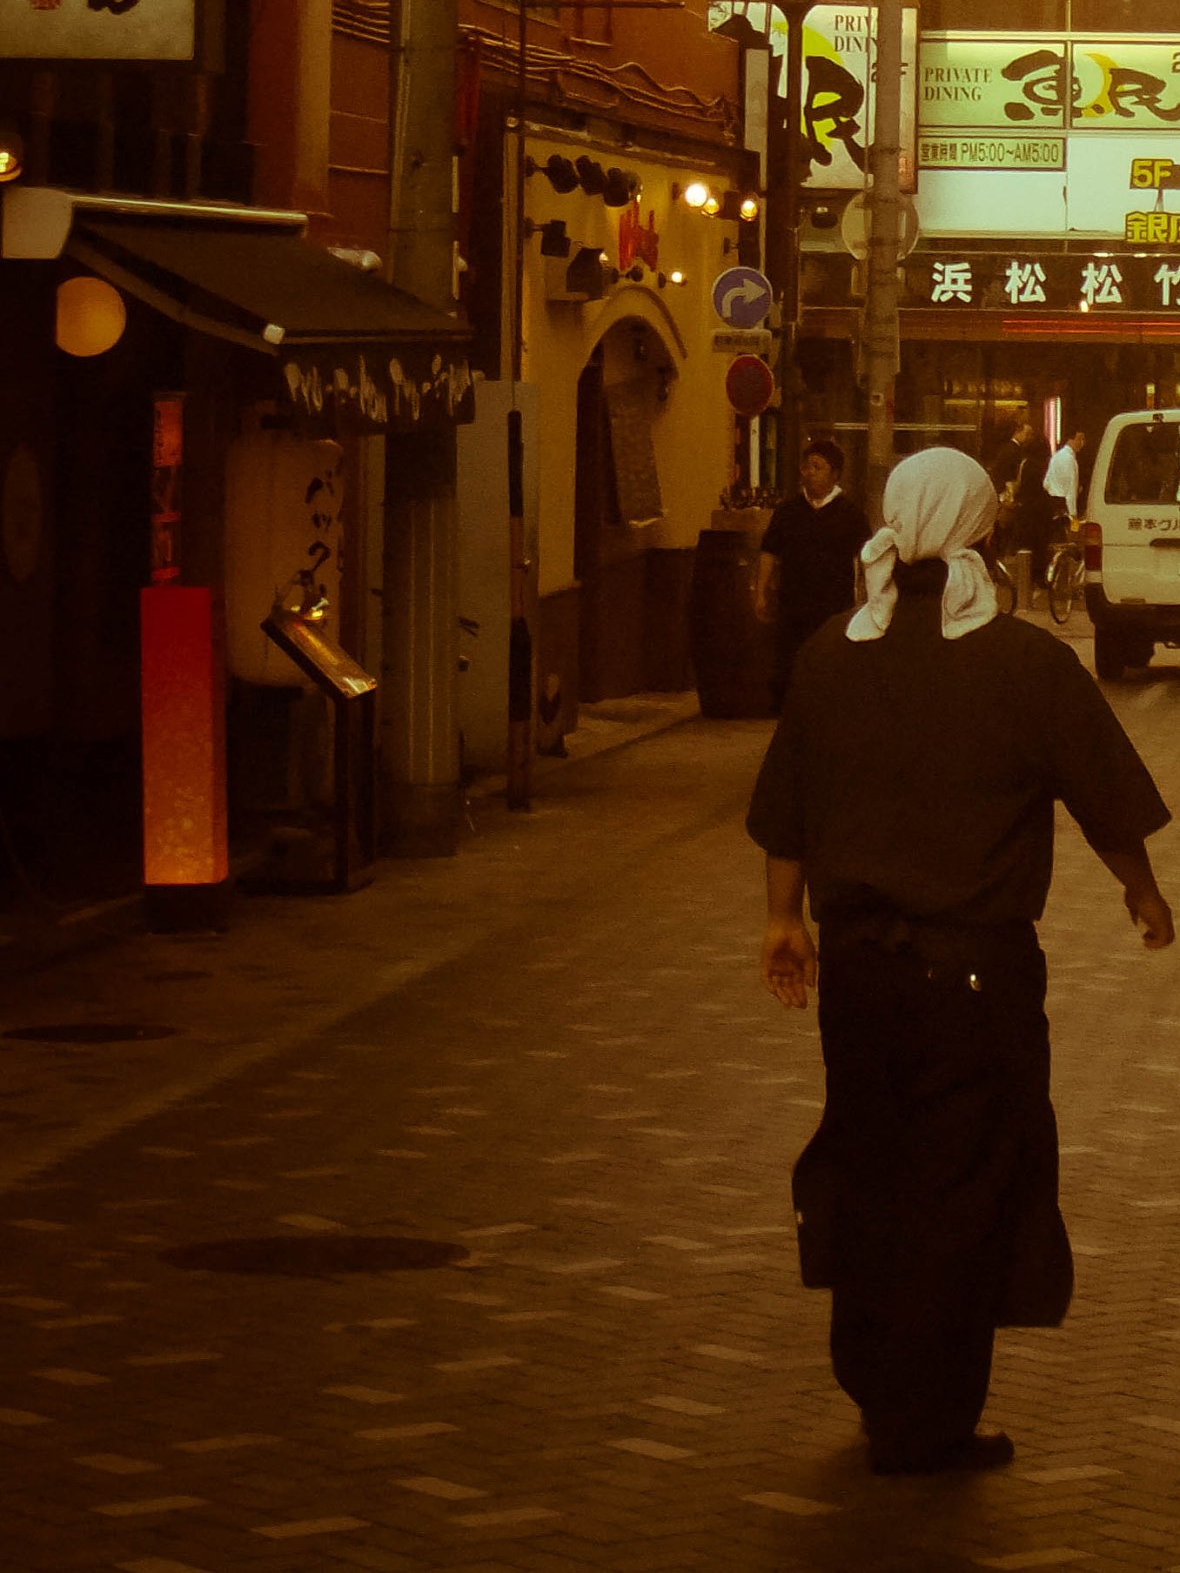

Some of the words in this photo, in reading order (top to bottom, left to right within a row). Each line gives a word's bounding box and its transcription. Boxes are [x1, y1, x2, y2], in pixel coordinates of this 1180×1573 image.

[924, 67, 993, 84] PRIVATE
[924, 86, 982, 102] DINING
[1133, 162, 1172, 188] 5F
